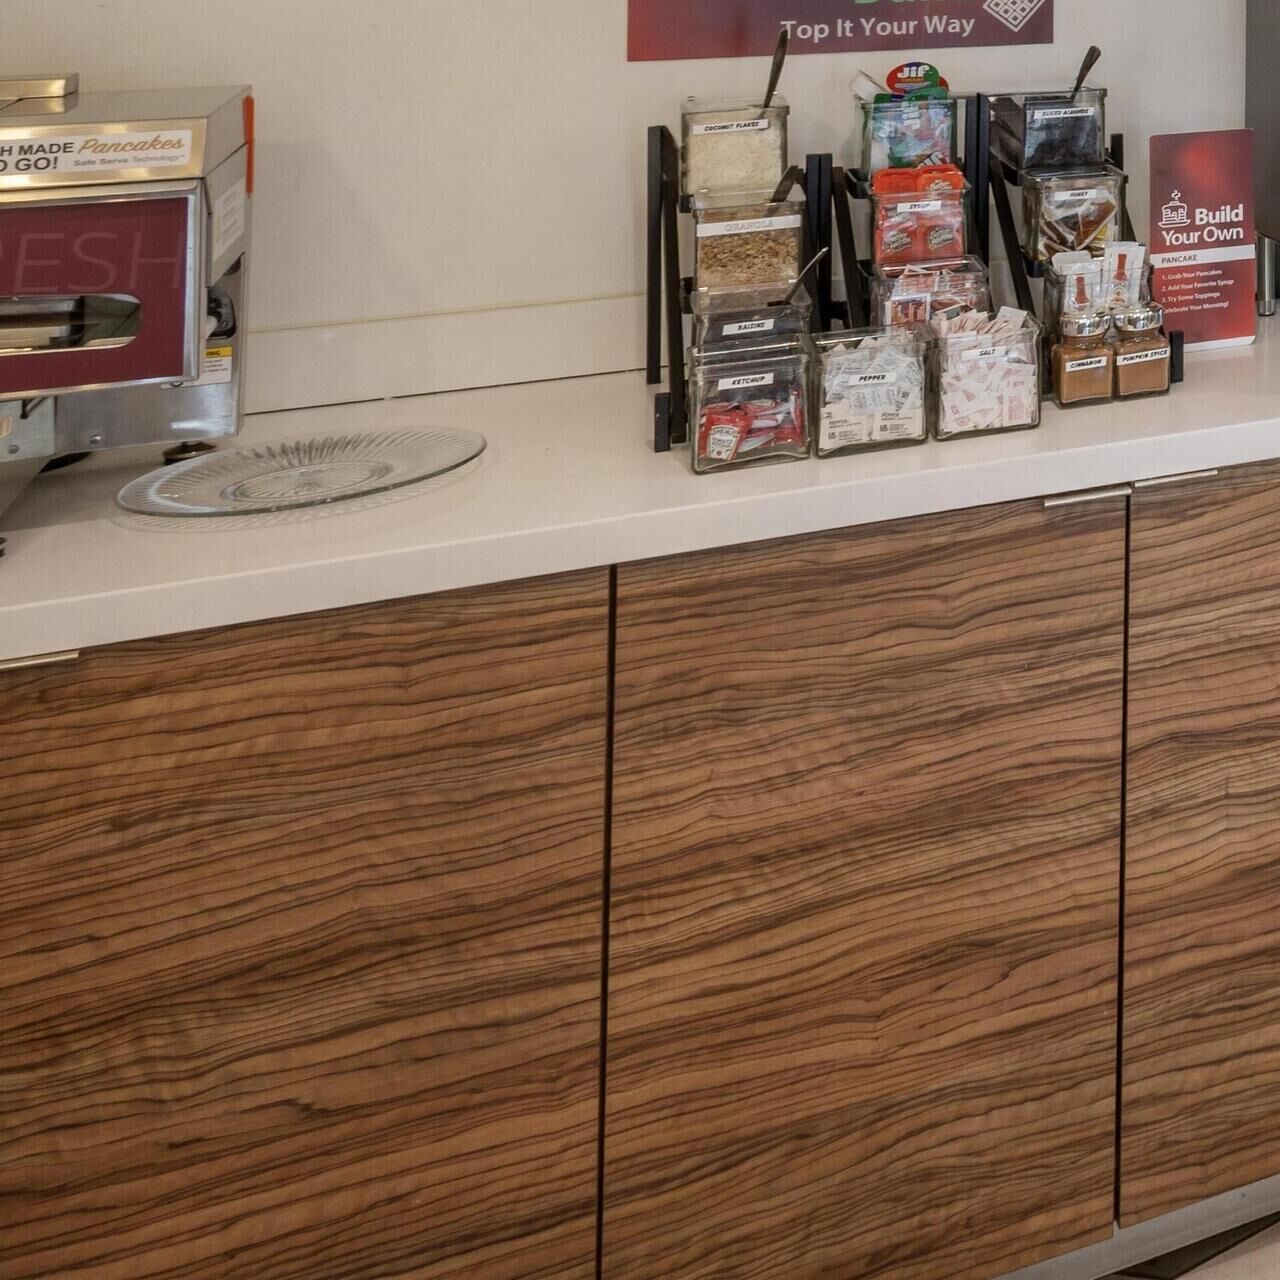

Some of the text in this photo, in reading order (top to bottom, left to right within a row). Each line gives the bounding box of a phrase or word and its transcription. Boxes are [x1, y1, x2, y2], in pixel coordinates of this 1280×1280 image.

[780, 14, 976, 44] Top It Your Way
[18, 142, 75, 156] MADE
[78, 135, 186, 155] Pancakes
[15, 156, 59, 171] GO!
[73, 159, 97, 167] Safe
[99, 157, 129, 166] Serve
[1194, 203, 1244, 225] Build
[1161, 225, 1244, 246] Your Own
[0, 230, 185, 293] ESH
[1161, 254, 1198, 264] PANCAKE
[1195, 269, 1222, 277] Pancakes
[1217, 279, 1234, 287] Syrup
[1194, 292, 1220, 300] Toppings
[979, 348, 996, 357] SALT
[1122, 349, 1168, 362] PUMPKIN SPICE
[1070, 358, 1102, 369] CINNAMON
[731, 375, 766, 385] KETCHUP
[858, 374, 886, 383] PEPPER
